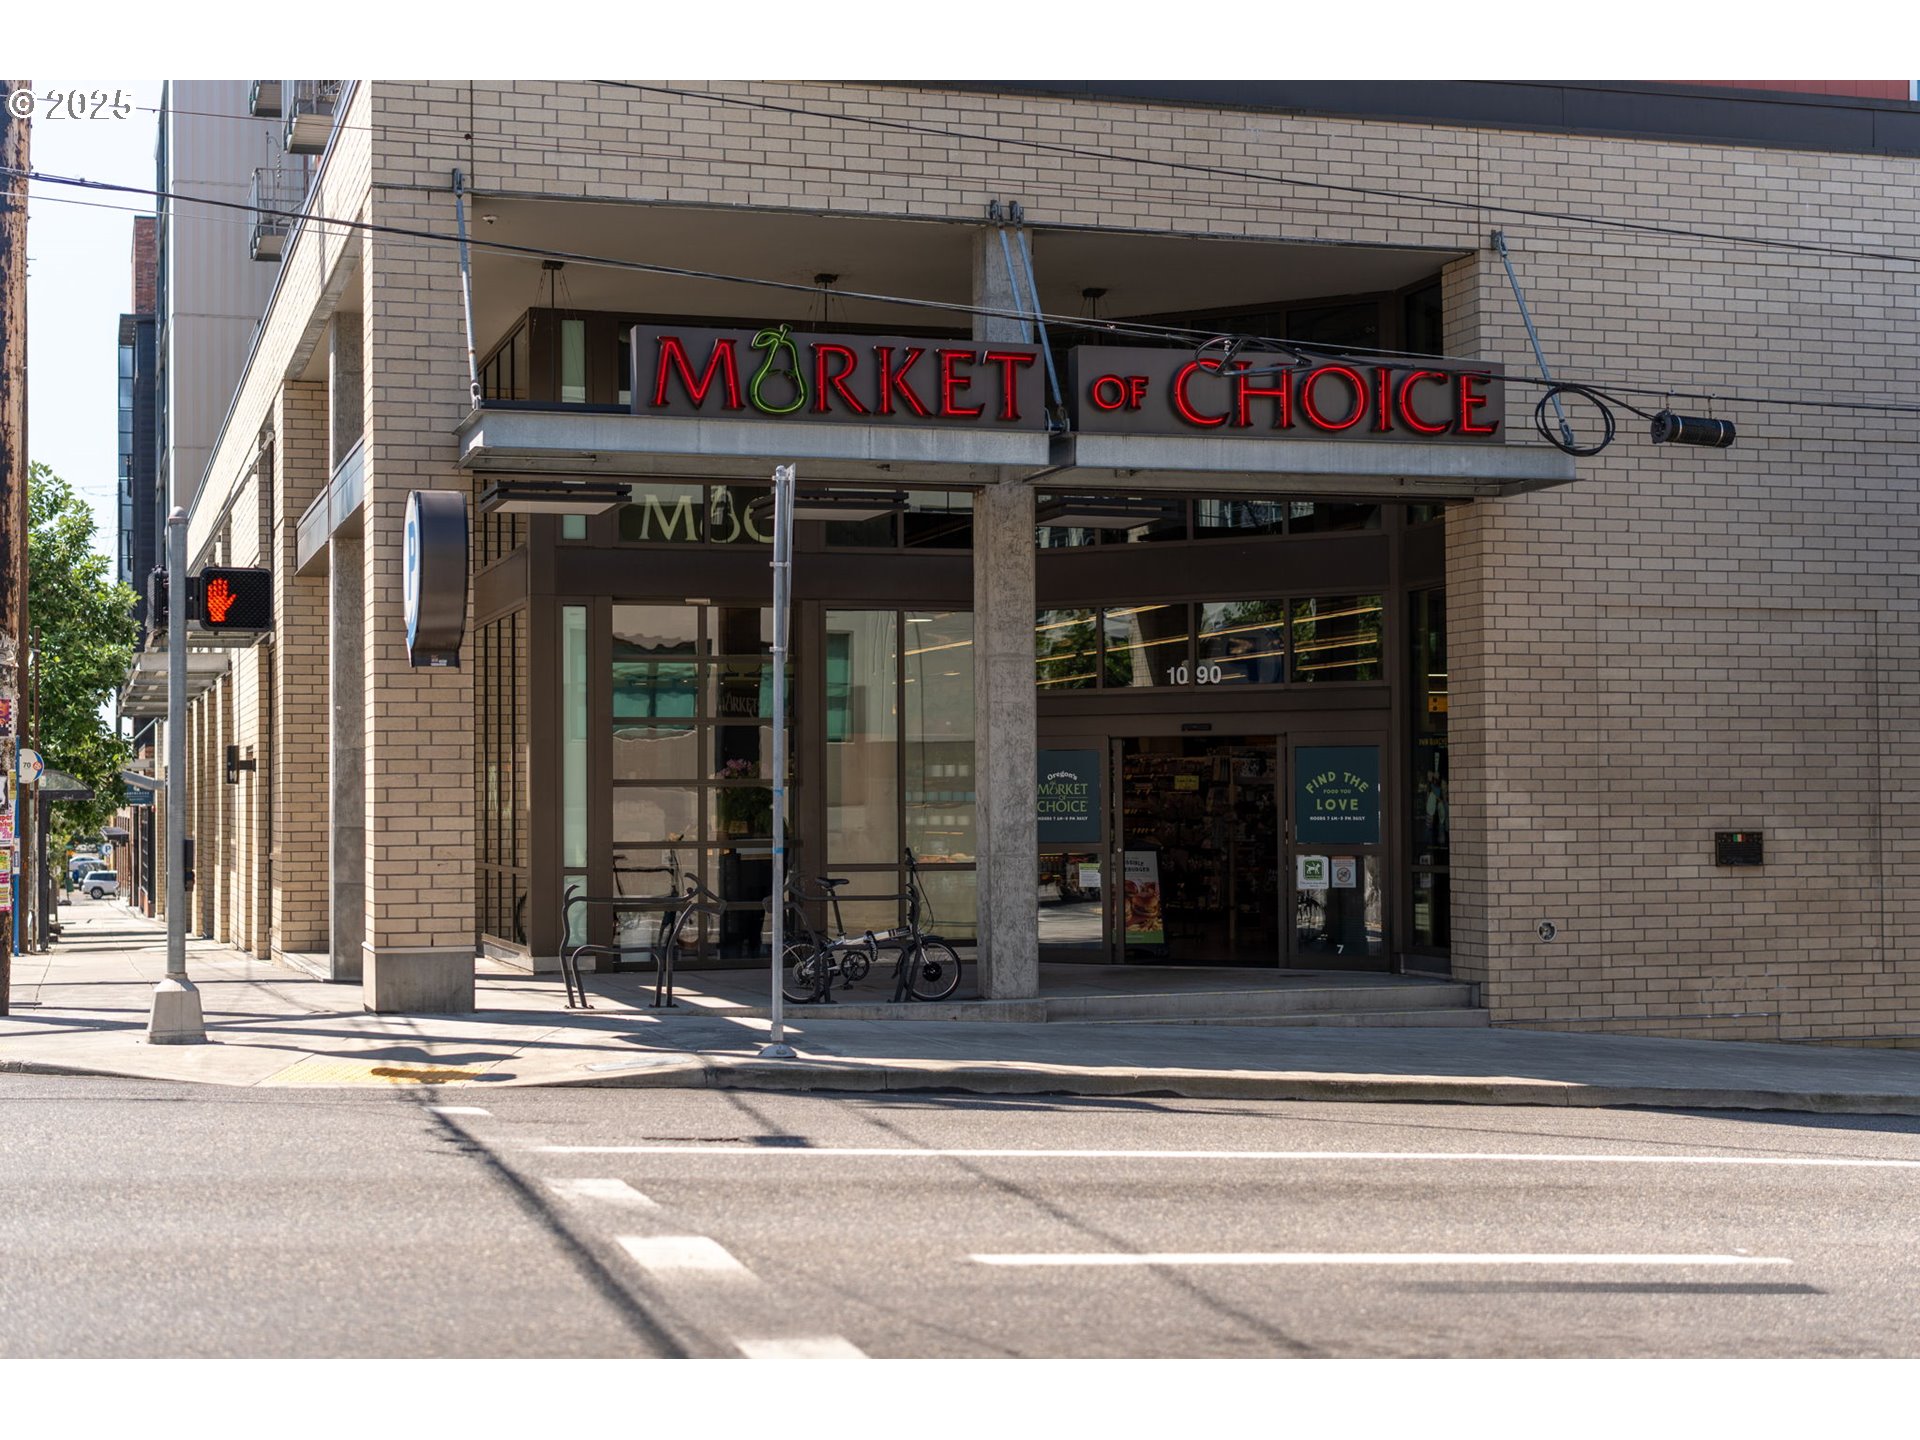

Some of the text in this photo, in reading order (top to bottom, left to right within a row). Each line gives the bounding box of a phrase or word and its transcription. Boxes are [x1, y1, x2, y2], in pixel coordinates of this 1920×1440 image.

[1091, 373, 1150, 411] OF
[1173, 357, 1499, 436] CHOICE
[1047, 770, 1078, 781] Oregon's
[1305, 771, 1369, 794] FIND THE
[1037, 801, 1088, 813] CHOICE
[1316, 799, 1359, 811] LOVE
[105, 845, 112, 853] P
[1336, 944, 1344, 954] 7
